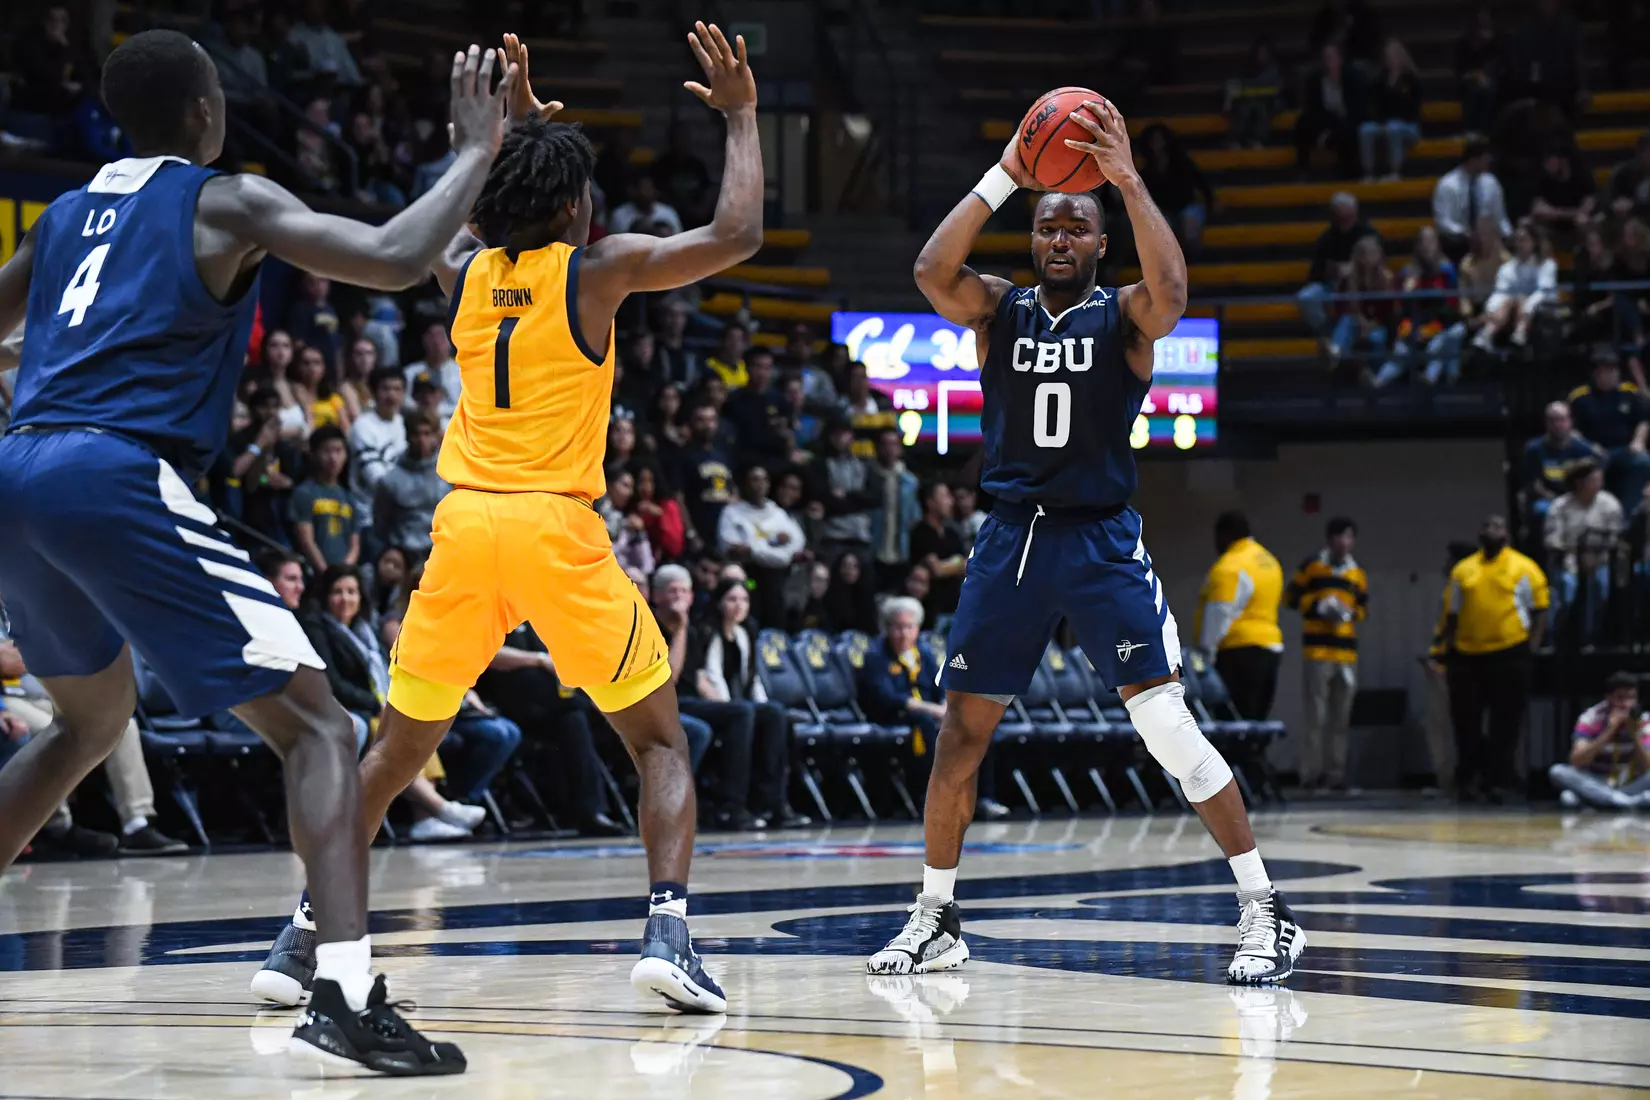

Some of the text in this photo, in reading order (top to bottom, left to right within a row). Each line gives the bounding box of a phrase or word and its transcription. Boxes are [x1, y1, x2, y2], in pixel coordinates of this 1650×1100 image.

[1023, 103, 1058, 149] NCAA
[81, 208, 117, 237] LO
[57, 243, 111, 328] 4
[492, 287, 533, 307] BROWN
[1082, 299, 1106, 310] WAC
[494, 316, 520, 409] 1
[1012, 337, 1094, 373] CBU
[899, 410, 922, 446] 9
[1033, 382, 1071, 448] 0
[1173, 413, 1197, 450] 8
